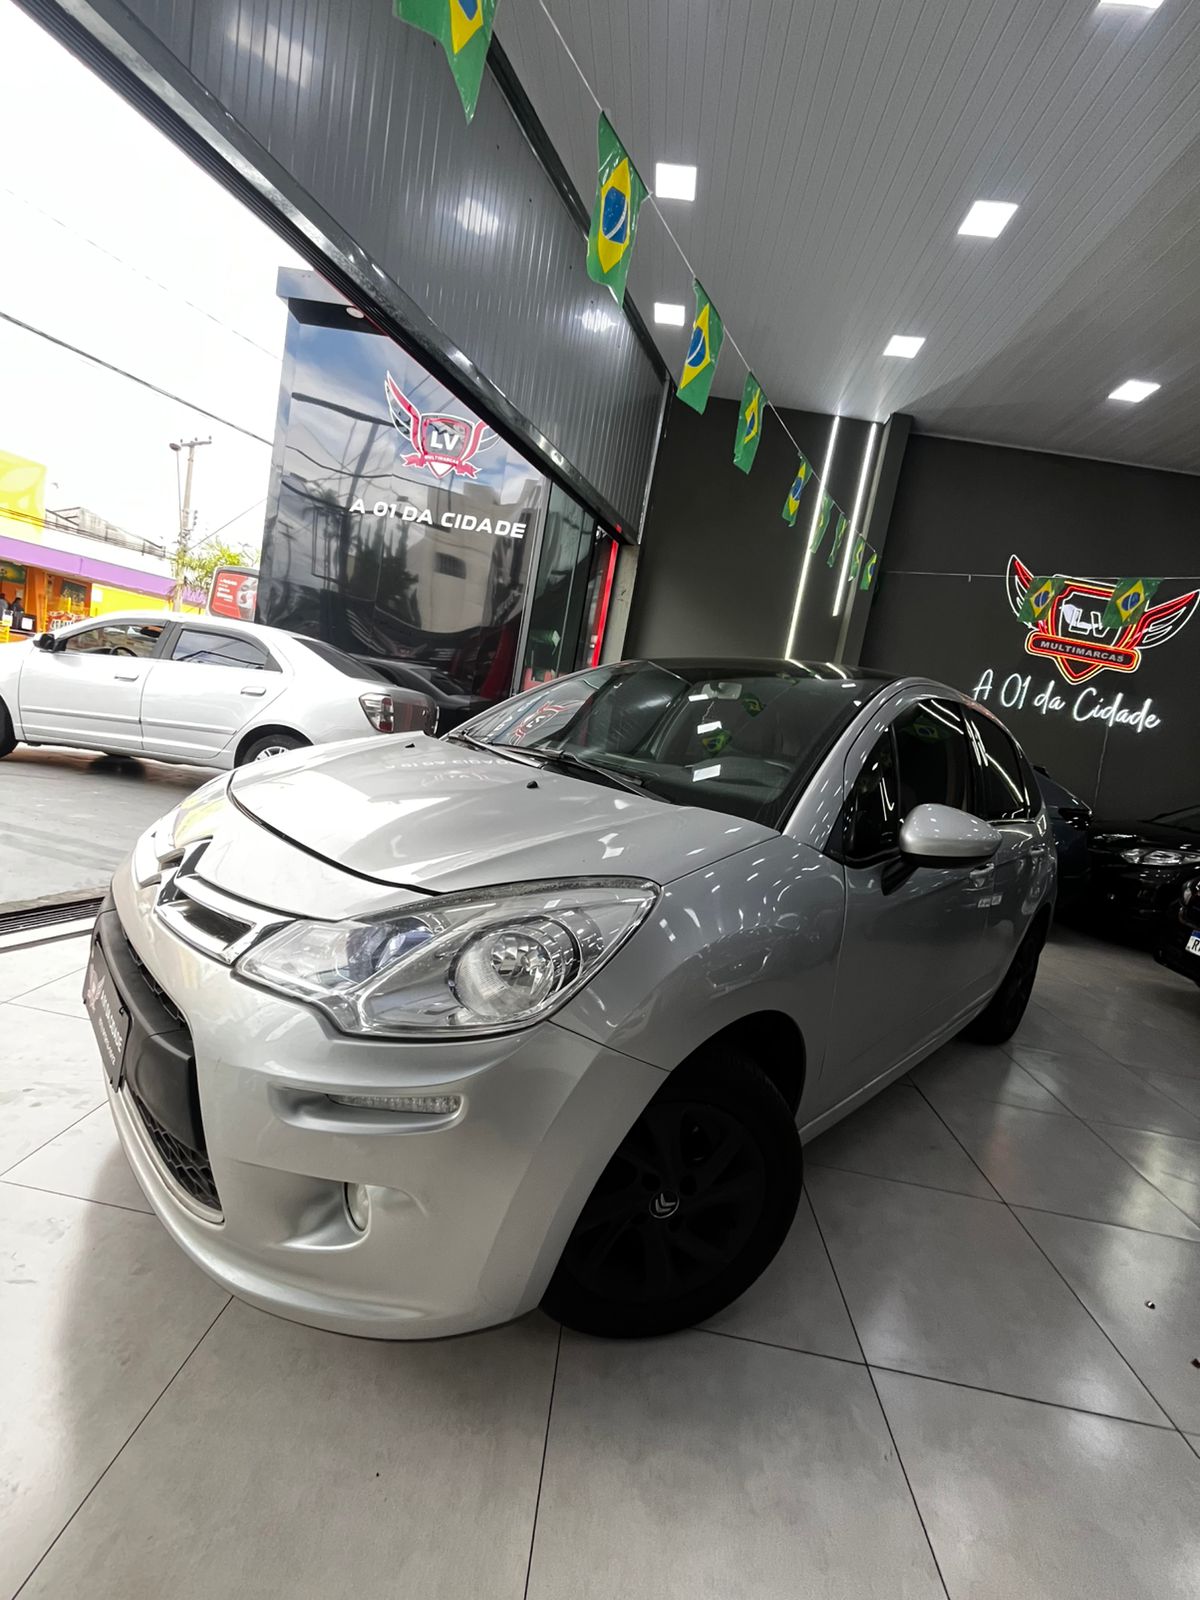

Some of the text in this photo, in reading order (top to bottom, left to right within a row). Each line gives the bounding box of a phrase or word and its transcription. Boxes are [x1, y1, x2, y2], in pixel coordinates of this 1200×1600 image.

[430, 430, 459, 451] LV
[349, 499, 527, 539] A 01 DA CIDADE
[1068, 607, 1110, 638] LV
[1040, 640, 1125, 663] MULTIMARCAS
[972, 668, 1161, 734] A 01 da Cidade
